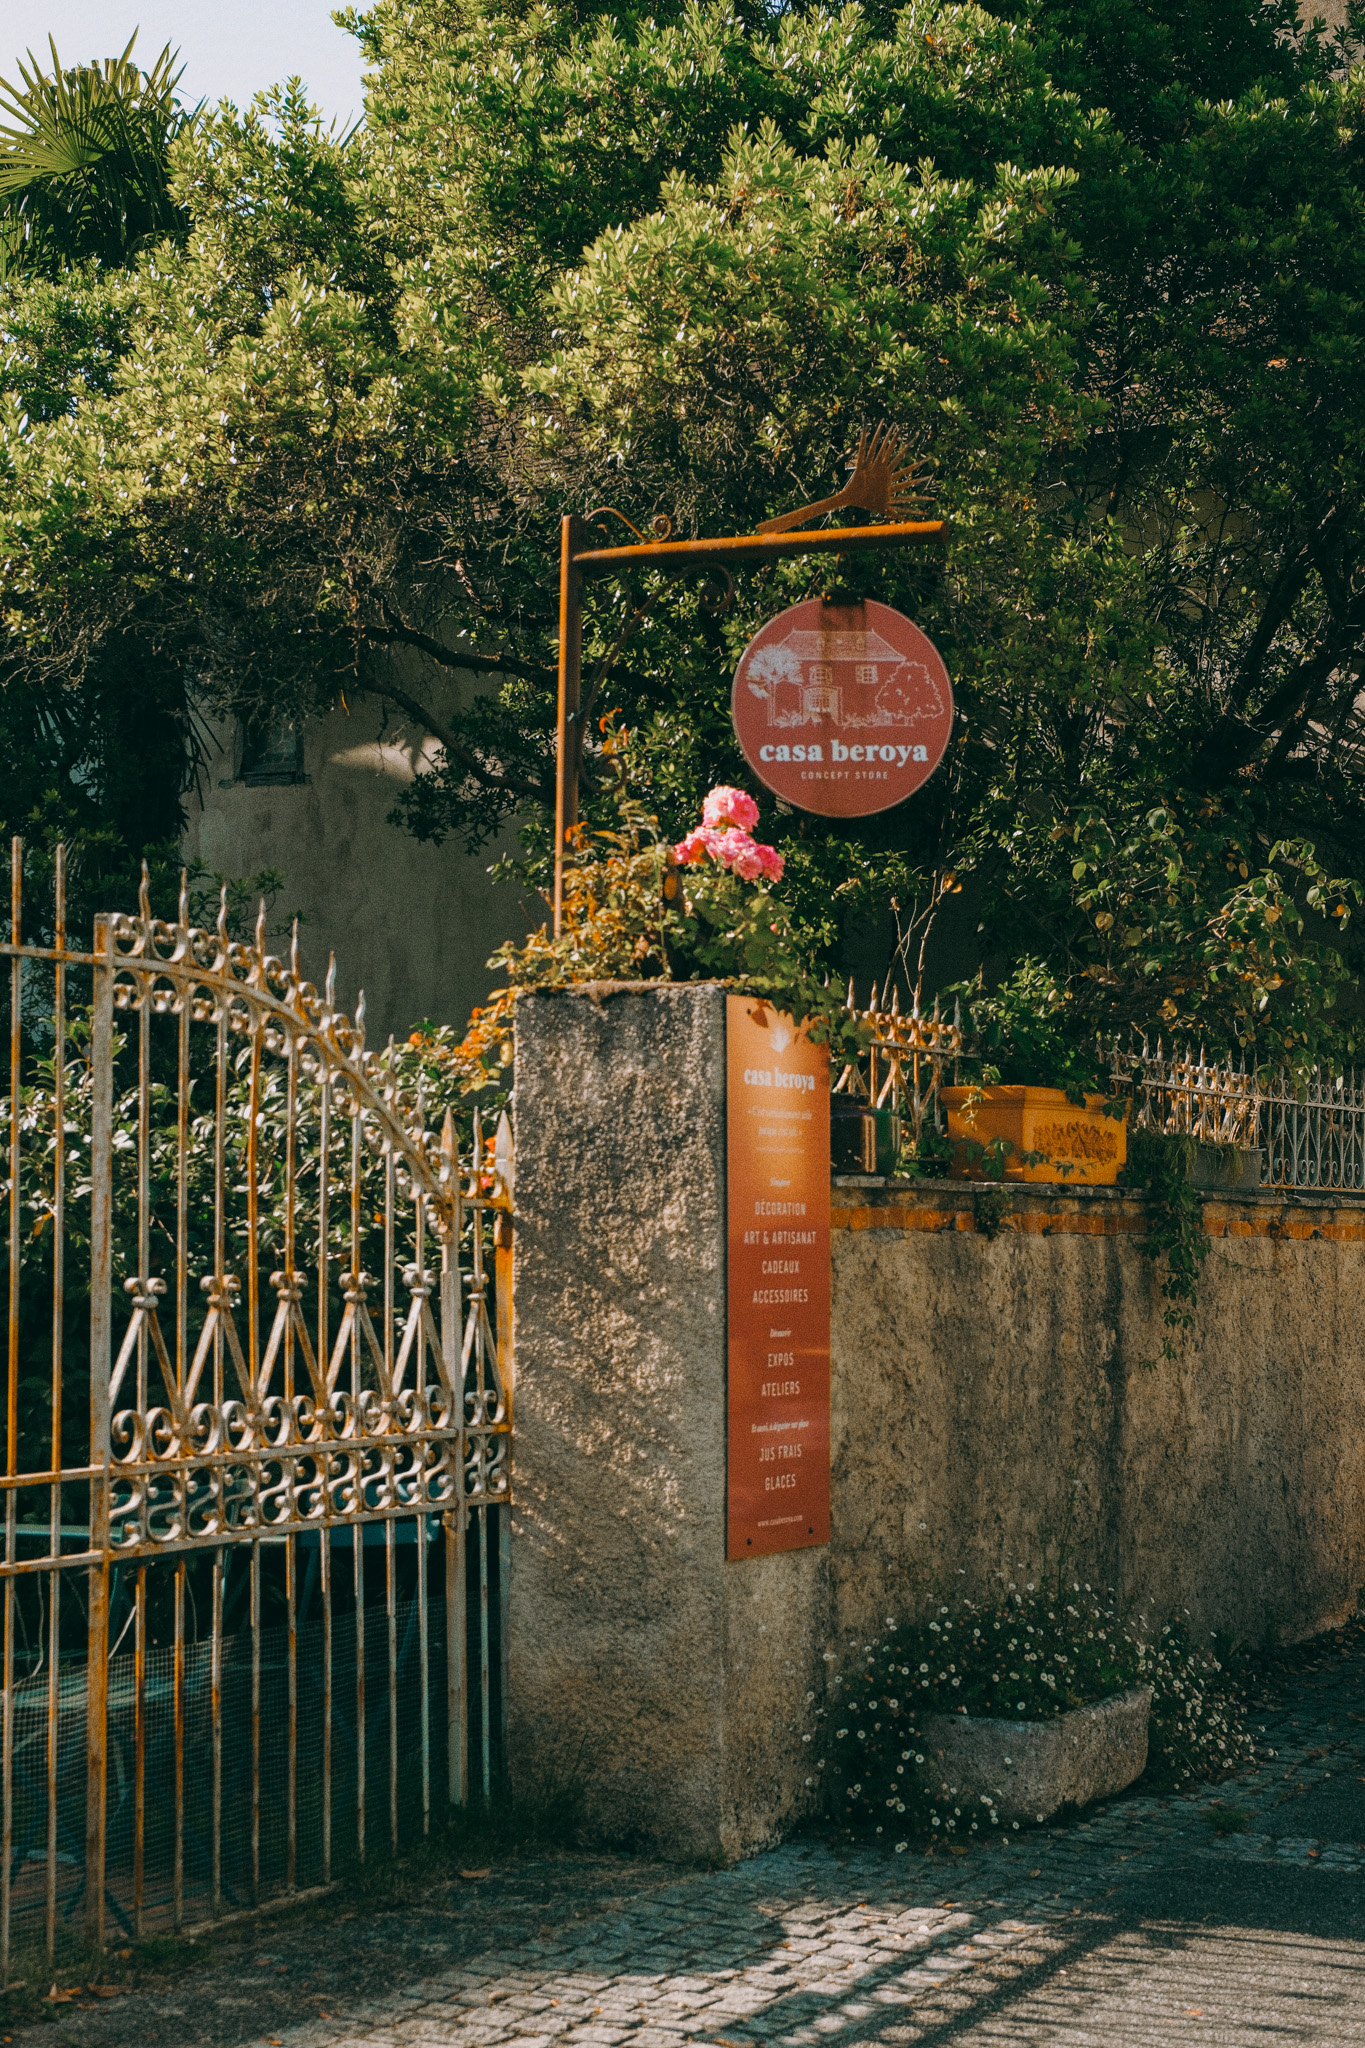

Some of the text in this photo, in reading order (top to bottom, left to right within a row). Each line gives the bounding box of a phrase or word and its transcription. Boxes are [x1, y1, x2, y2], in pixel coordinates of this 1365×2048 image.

[759, 739, 929, 767] casa beroya
[801, 771, 889, 780] CONCEPT STORE
[744, 1066, 815, 1094] casa beroya
[754, 1199, 806, 1216] DÉCORATION
[744, 1230, 817, 1245] ART & ARTISANAT
[762, 1260, 800, 1274] CADEAUX
[752, 1289, 809, 1304] ACCESSOIRES
[767, 1352, 794, 1367] EXPOS
[761, 1381, 800, 1397] ATELIERS
[759, 1443, 803, 1462] JUS FRAIS
[764, 1473, 797, 1491] GLACES
